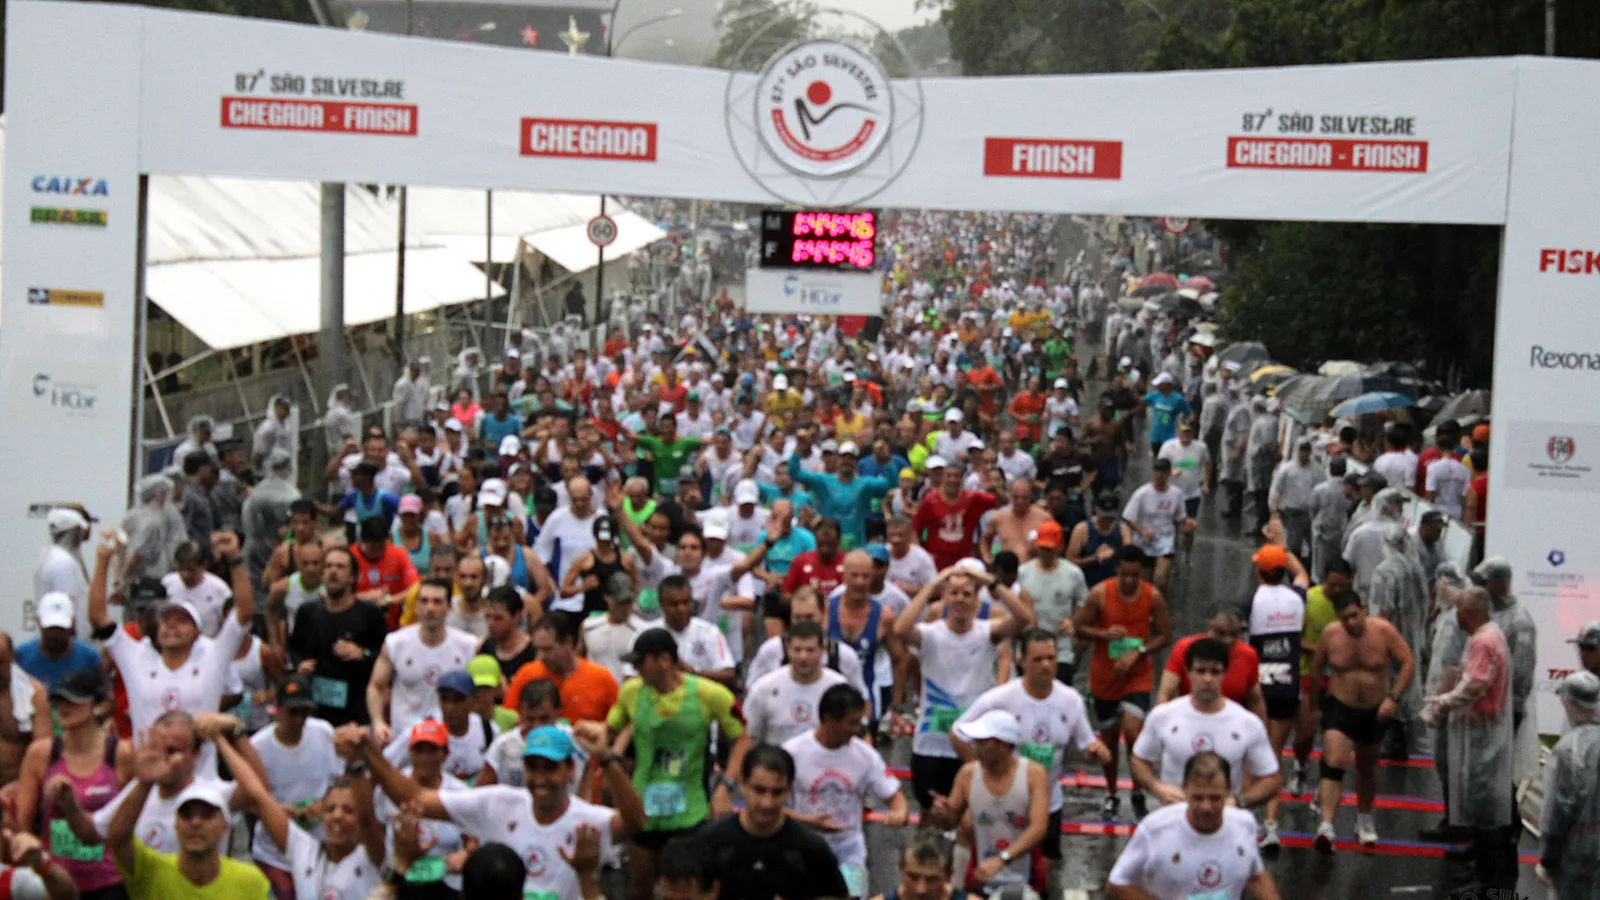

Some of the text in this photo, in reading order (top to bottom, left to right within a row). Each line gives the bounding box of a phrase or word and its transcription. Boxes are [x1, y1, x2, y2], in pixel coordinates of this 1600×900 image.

[228, 101, 325, 128] CHEGADA
[343, 105, 412, 132] FINISH
[530, 122, 648, 156] CHEGADA
[1012, 143, 1096, 174] FINISH
[1235, 140, 1333, 166] CHEGADA
[1352, 145, 1421, 169] FINISH
[31, 175, 108, 196] CAIXA
[592, 222, 613, 239] 60
[765, 240, 778, 259] F
[1530, 344, 1600, 370] Rexona
